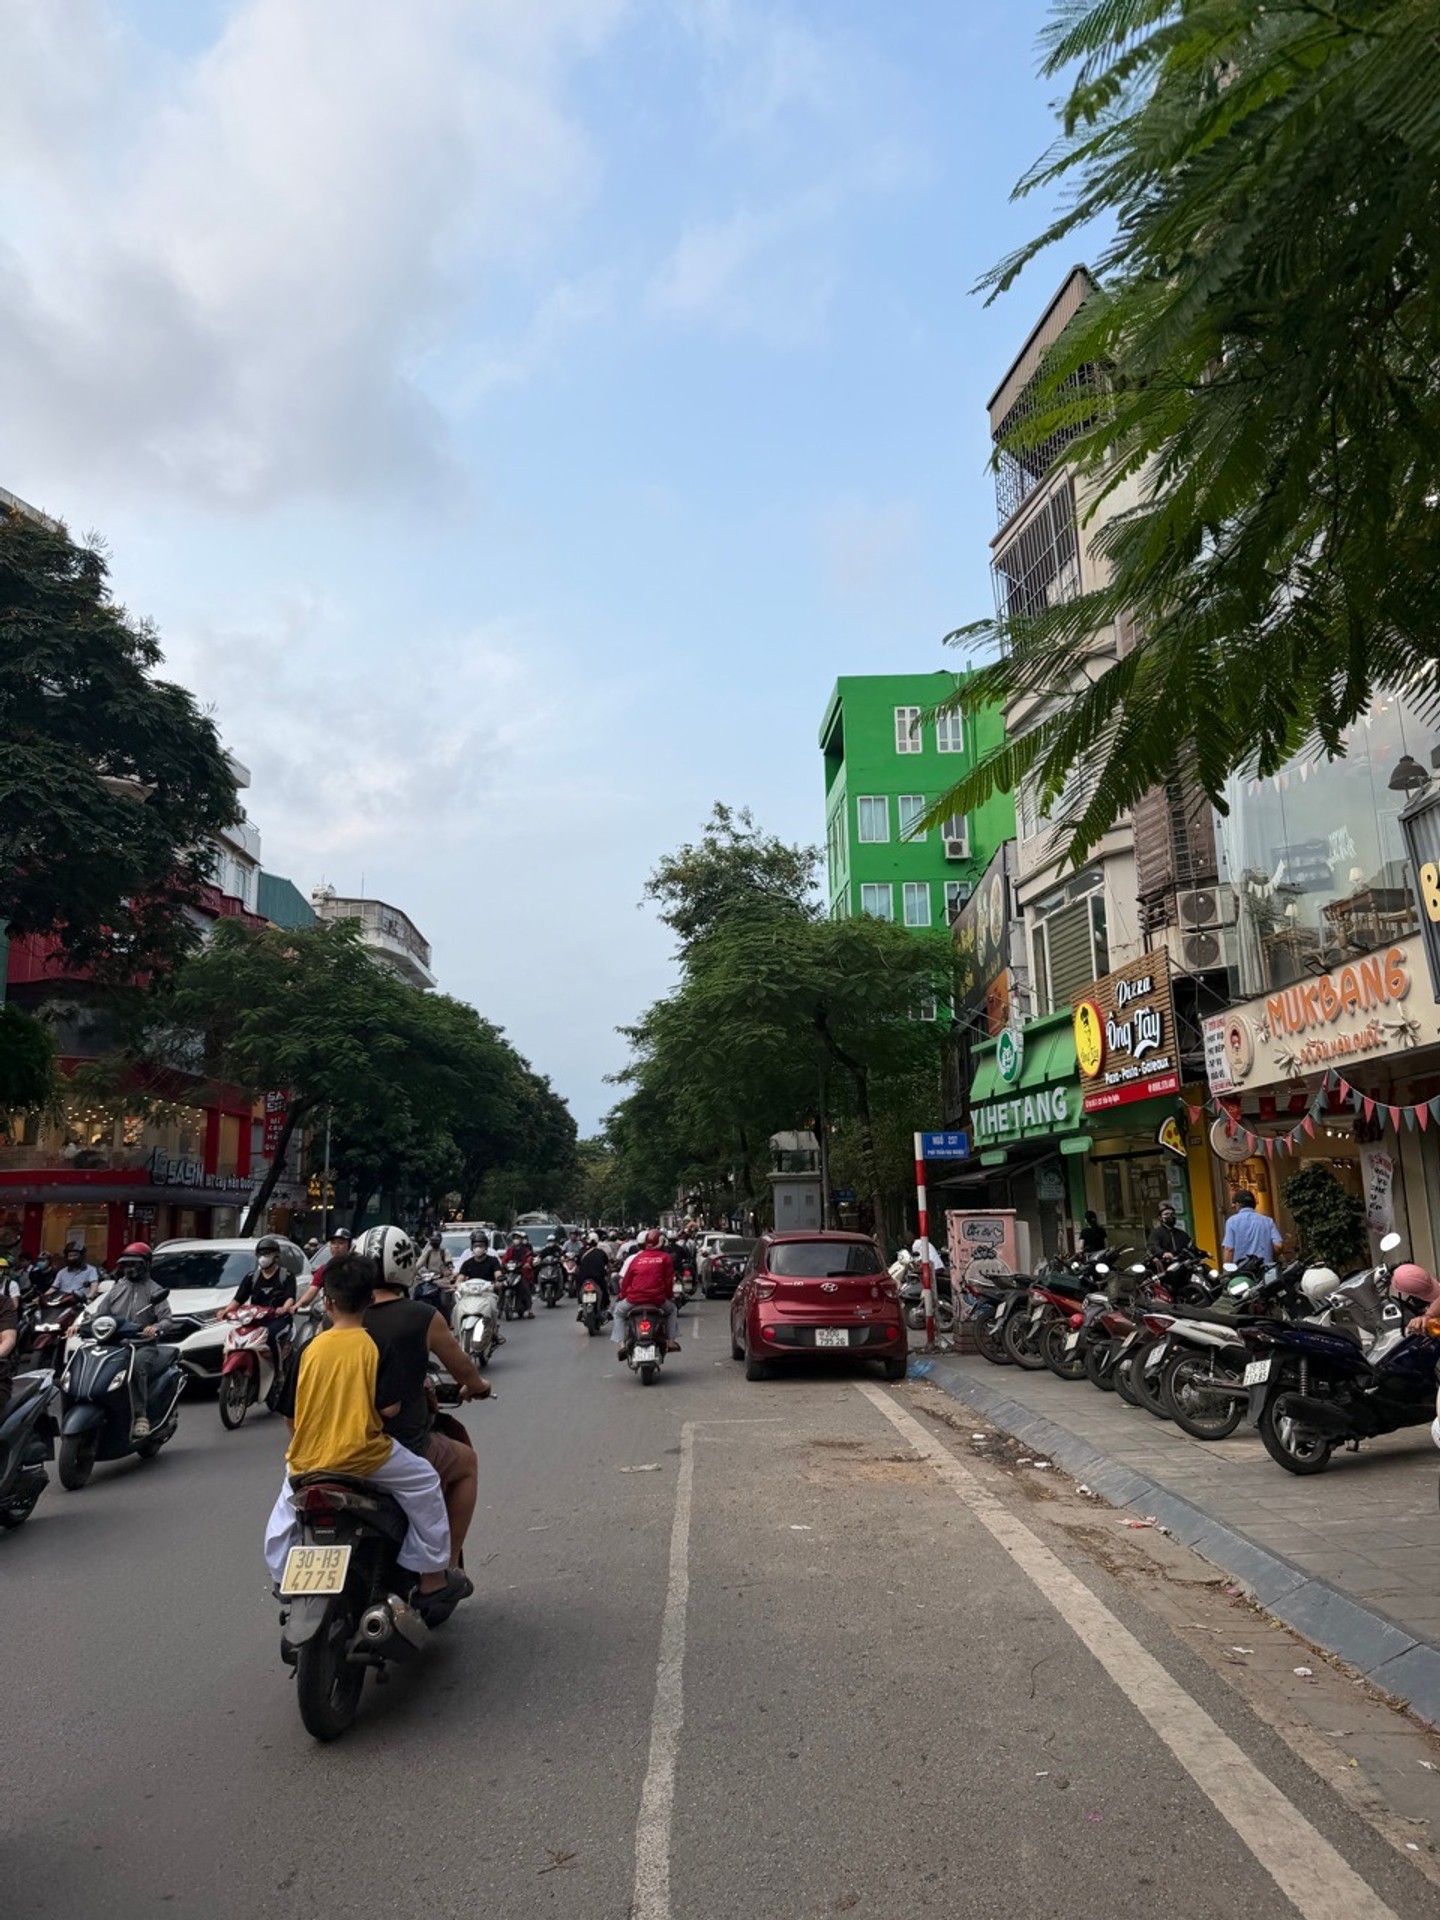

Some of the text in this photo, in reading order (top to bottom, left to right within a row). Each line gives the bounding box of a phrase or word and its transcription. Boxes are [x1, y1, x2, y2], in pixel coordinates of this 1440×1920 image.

[1115, 976, 1151, 1007] Pizza
[1266, 947, 1407, 1037] MUKBANG
[1106, 1013, 1131, 1055] Ông
[1133, 1005, 1161, 1059] Tây
[1330, 1032, 1352, 1056] HÀN
[1353, 1018, 1386, 1050] QUỐC
[970, 1086, 1068, 1137] YIHETANG
[296, 1549, 341, 1569] 30-H3
[291, 1570, 337, 1590] 4775
